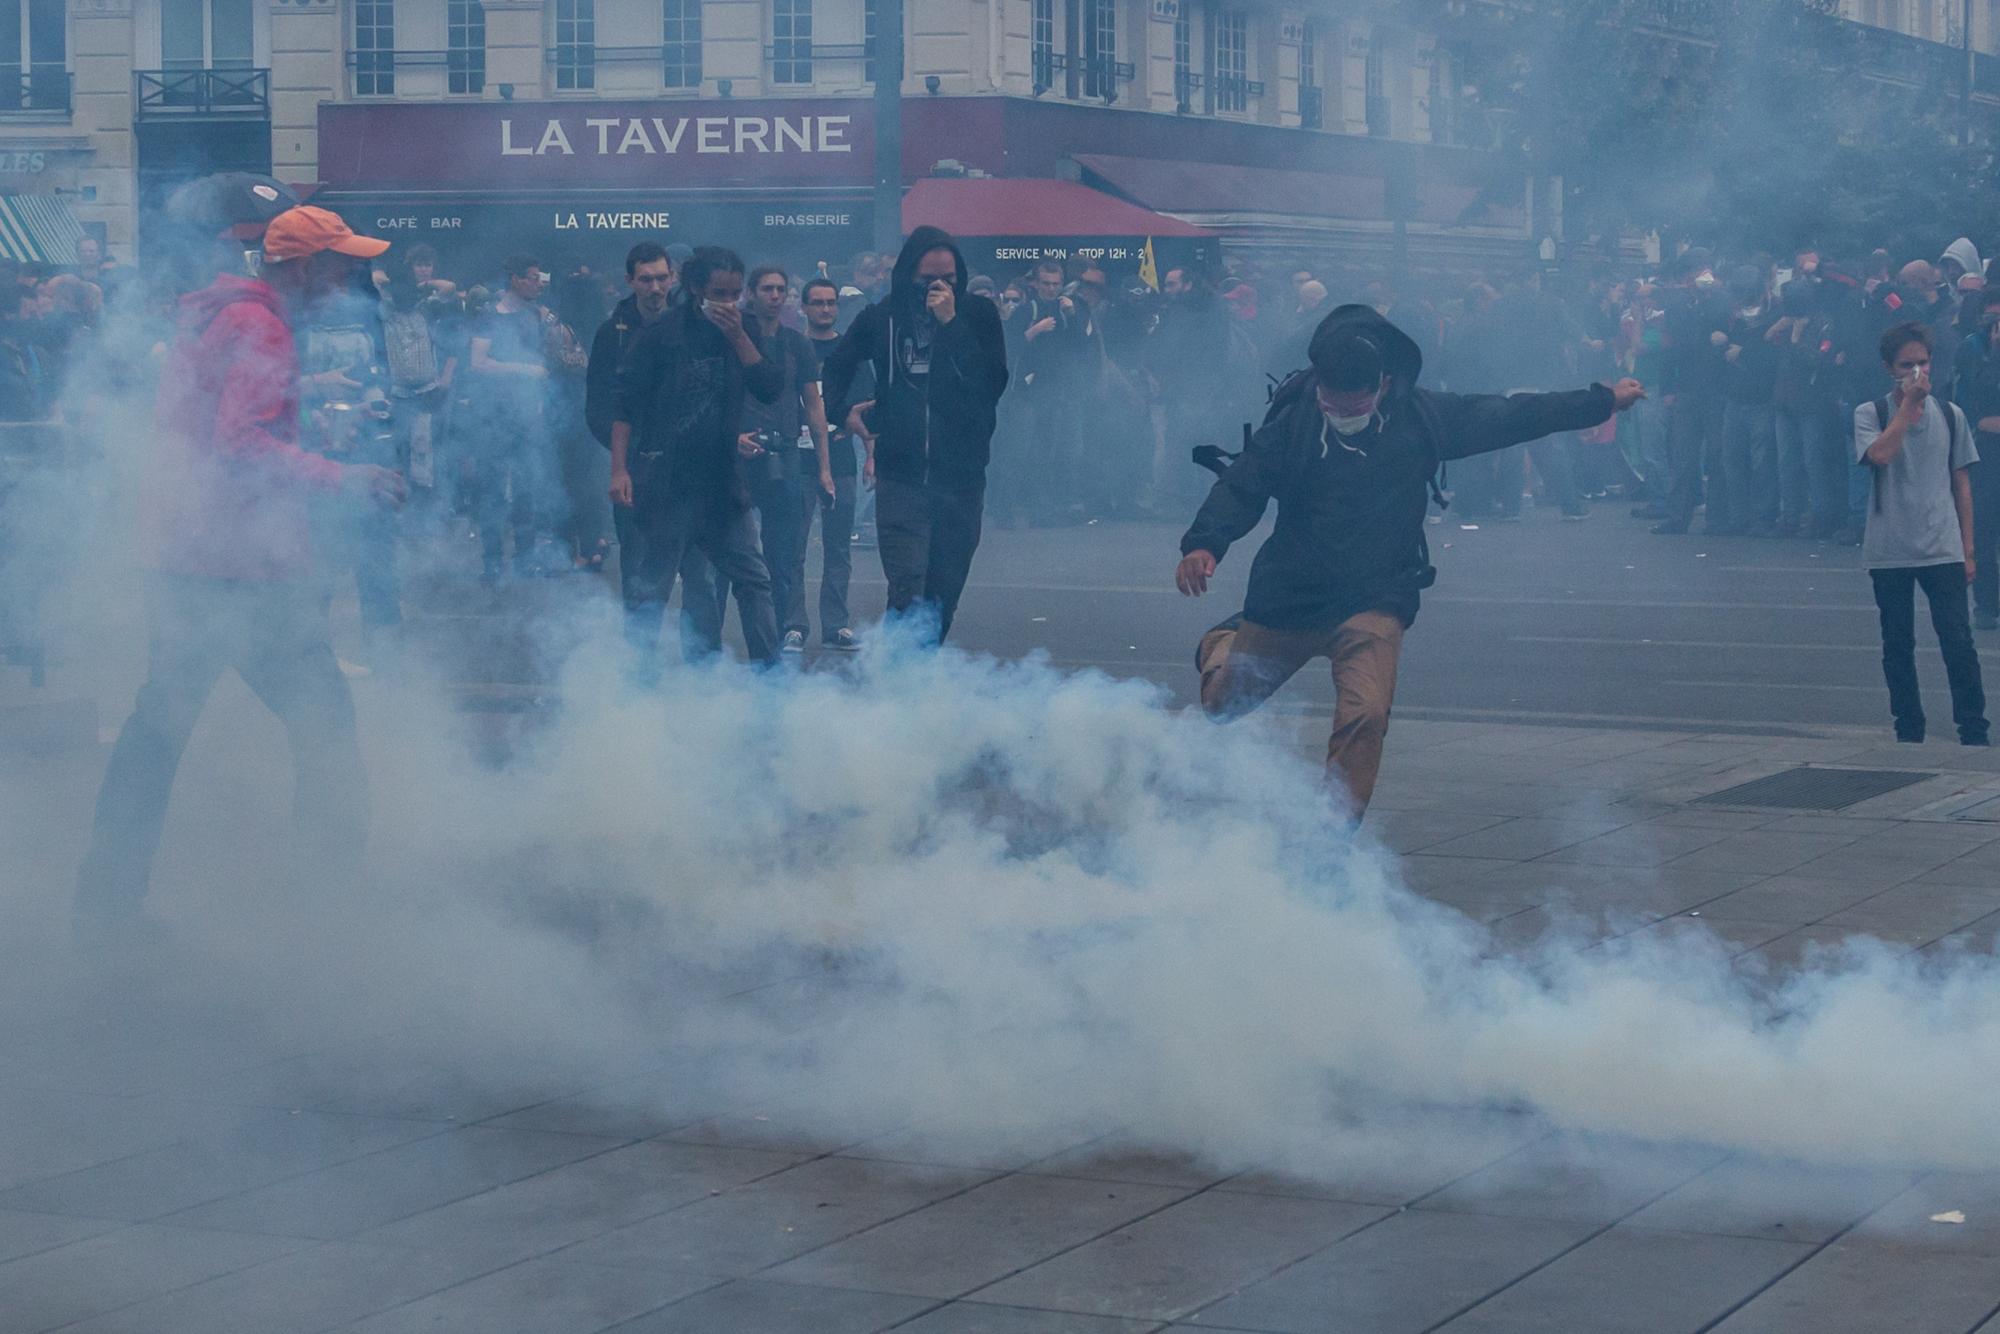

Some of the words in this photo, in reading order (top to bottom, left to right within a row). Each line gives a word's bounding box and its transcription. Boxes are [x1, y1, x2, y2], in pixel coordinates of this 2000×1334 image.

[501, 119, 575, 156] LA
[586, 115, 852, 155] TAVERNE
[431, 217, 462, 229] BAR
[555, 213, 579, 229] LA
[586, 212, 670, 229] TAVERNE
[764, 214, 850, 226] BRASSERIE
[995, 248, 1040, 260] SERVICE
[1043, 248, 1067, 260] NON
[1078, 248, 1105, 259] STOP
[1108, 248, 1127, 259] 12H
